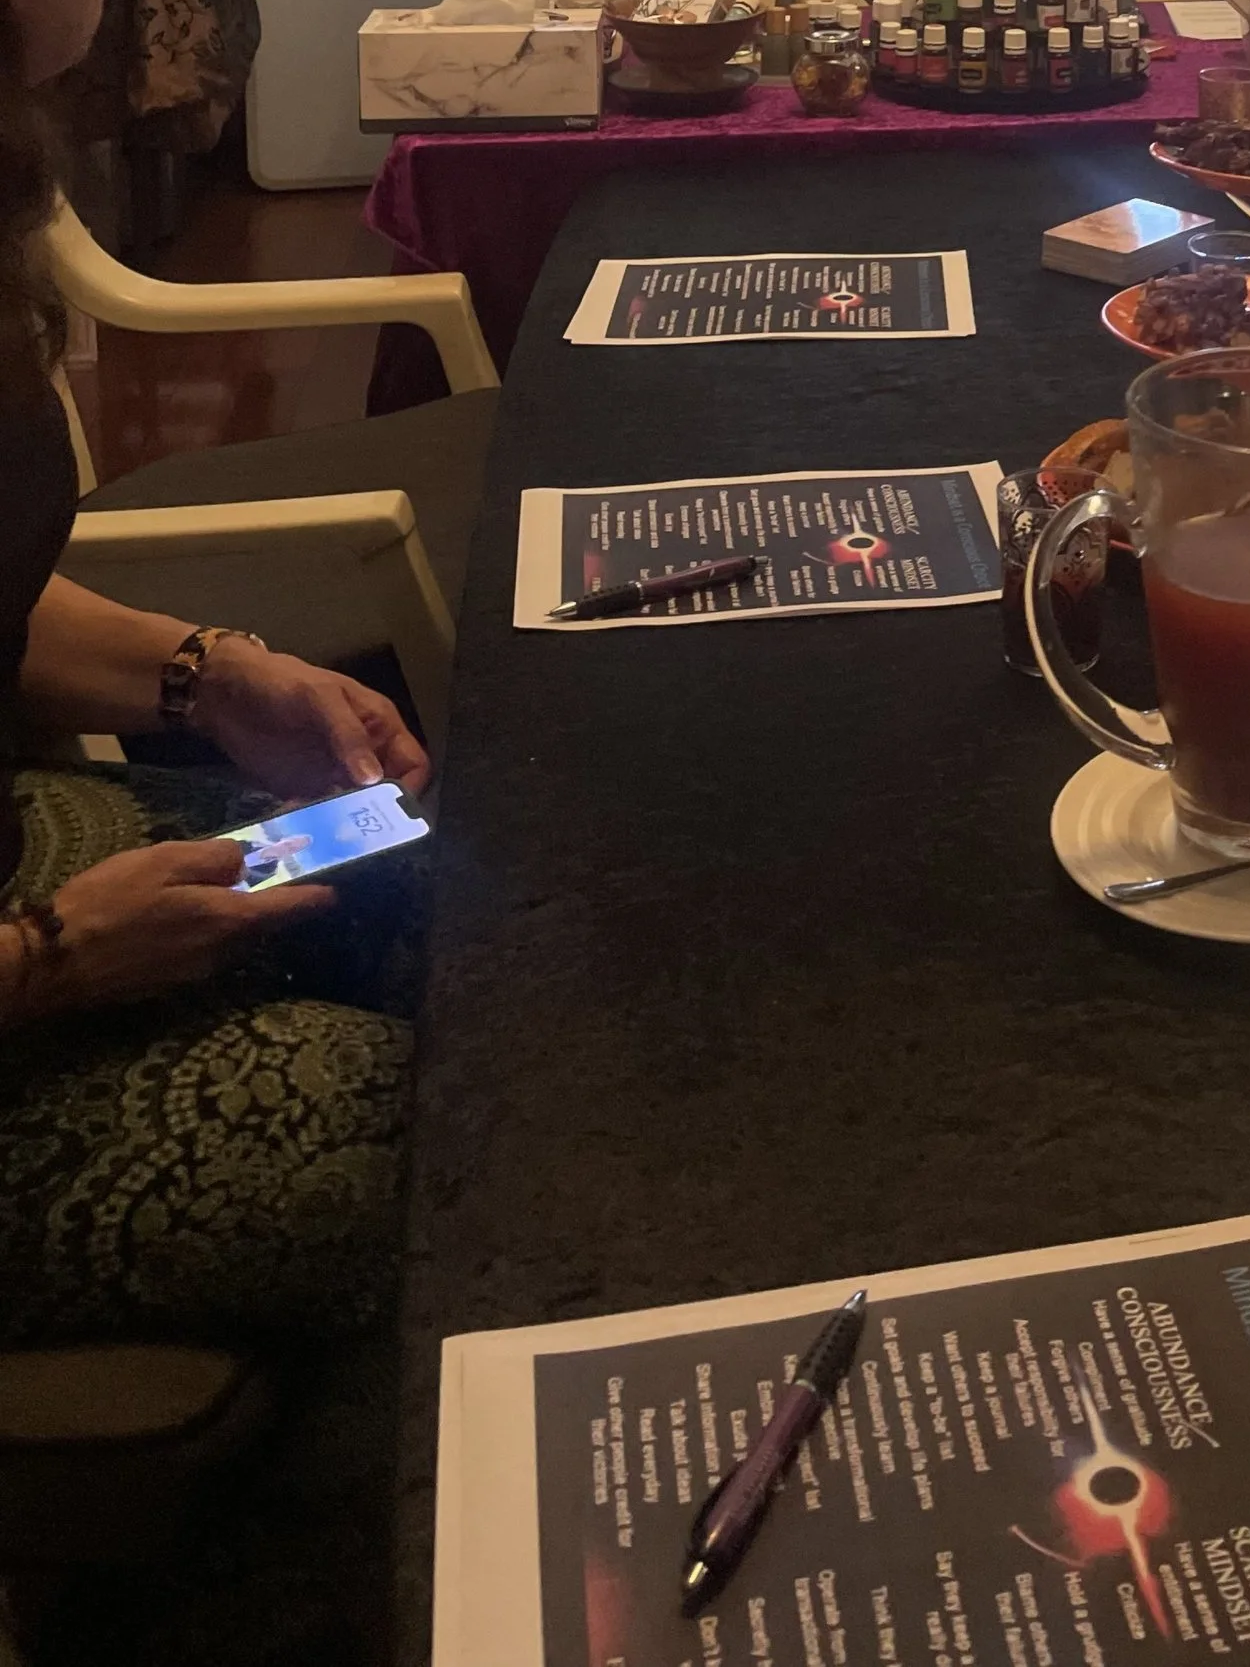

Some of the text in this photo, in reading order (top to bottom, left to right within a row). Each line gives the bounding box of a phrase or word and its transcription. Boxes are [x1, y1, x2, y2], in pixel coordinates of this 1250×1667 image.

[900, 559, 921, 589] MINDSET
[915, 556, 938, 589] SCARCITY
[349, 806, 383, 837] 1:52
[881, 1318, 898, 1339] Set
[883, 1341, 904, 1374] goals
[893, 1376, 912, 1398] and
[918, 1352, 935, 1383] Keep
[925, 1386, 938, 1395] a
[977, 1351, 1013, 1439] Keep a journal
[1005, 1352, 1036, 1427] their failures
[1013, 1318, 1065, 1457] Accept responsibility for
[1048, 1339, 1085, 1425] Forgive others
[1078, 1341, 1112, 1411] Compliment
[1092, 1299, 1153, 1446] Have a sense of gratitude
[1116, 1286, 1192, 1450] CONSCIOUSNESS
[1147, 1301, 1213, 1426] ABUNDANCE
[696, 1363, 720, 1473] Share information
[861, 1360, 895, 1474] Continuously learn
[900, 1400, 920, 1449] develop
[942, 1330, 992, 1472] Want others to succeed
[590, 1418, 609, 1505] their victories
[607, 1376, 634, 1547] Give other people credit for
[640, 1407, 661, 1503] Read everyday
[670, 1398, 693, 1504] Talk about ideas
[842, 1417, 875, 1523] transformational
[938, 1439, 956, 1460] list
[913, 1474, 933, 1510] plans
[935, 1550, 953, 1578] Say
[943, 1580, 962, 1612] they
[1015, 1572, 1039, 1618] Blame
[1064, 1571, 1088, 1605] Hold
[748, 1597, 771, 1656] Secretly
[817, 1569, 846, 1664] Operate from
[871, 1585, 897, 1660] Think they
[995, 1591, 1016, 1623] their
[1073, 1609, 1088, 1618] a
[1117, 1583, 1146, 1640] Criticize
[1159, 1564, 1200, 1642] entitlement
[1174, 1540, 1231, 1654] Have a sense of
[952, 1614, 972, 1651] keep
